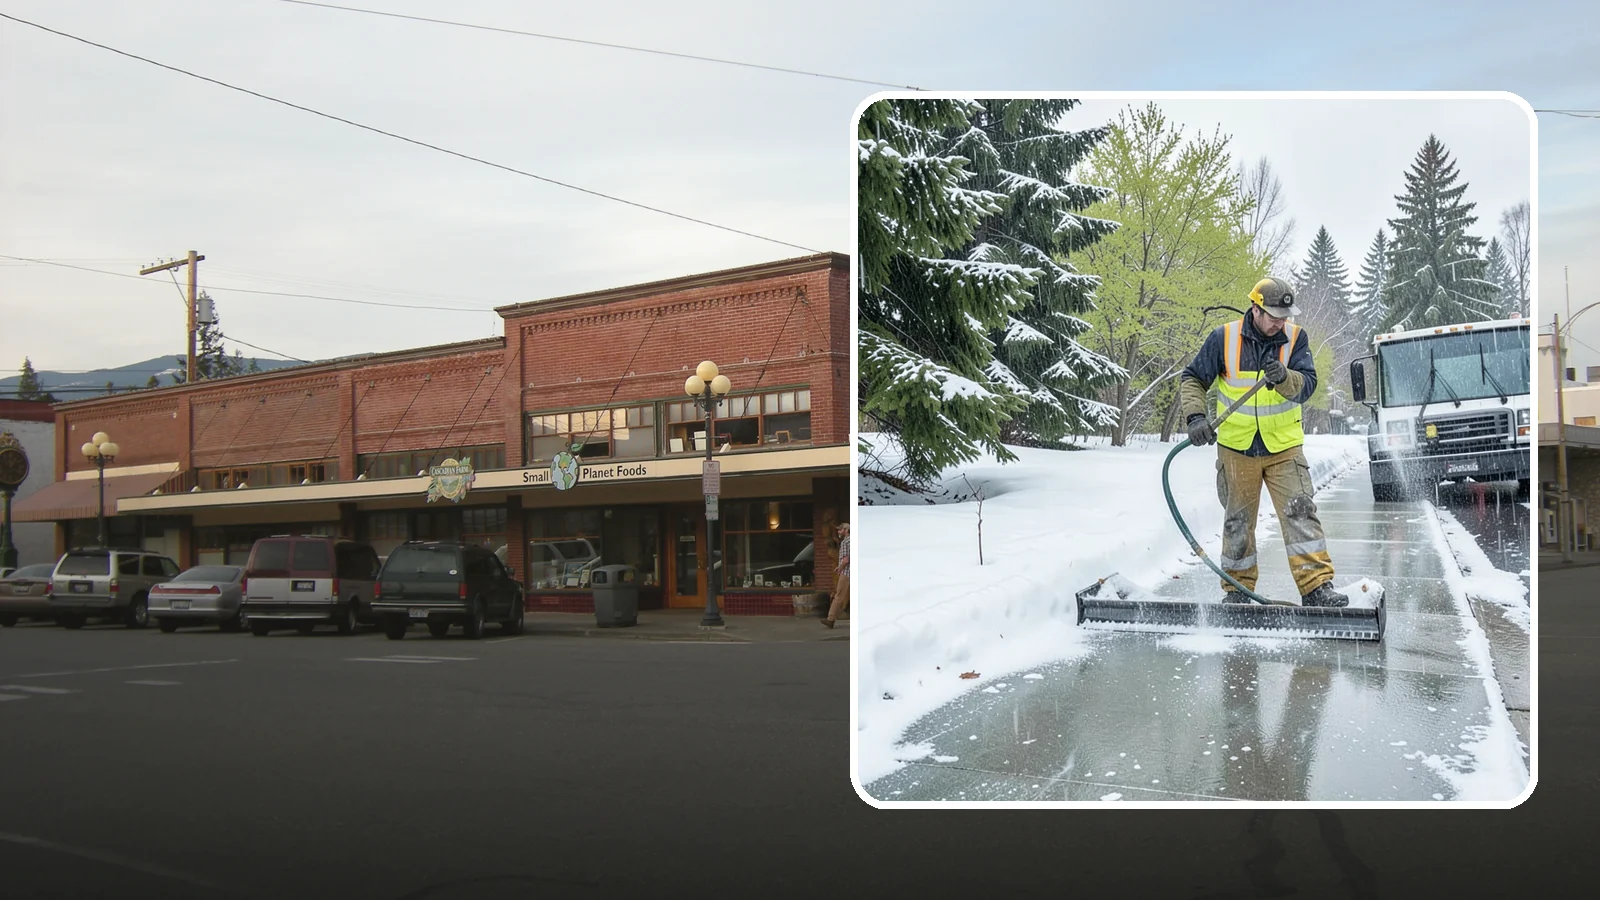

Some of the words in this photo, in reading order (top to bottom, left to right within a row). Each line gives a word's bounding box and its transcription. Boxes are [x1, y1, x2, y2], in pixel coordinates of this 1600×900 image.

[431, 467, 454, 476] CASCADIAN
[455, 466, 469, 474] FARM
[523, 472, 549, 483] Small
[583, 468, 614, 480] Planet
[617, 465, 647, 477] Foods
